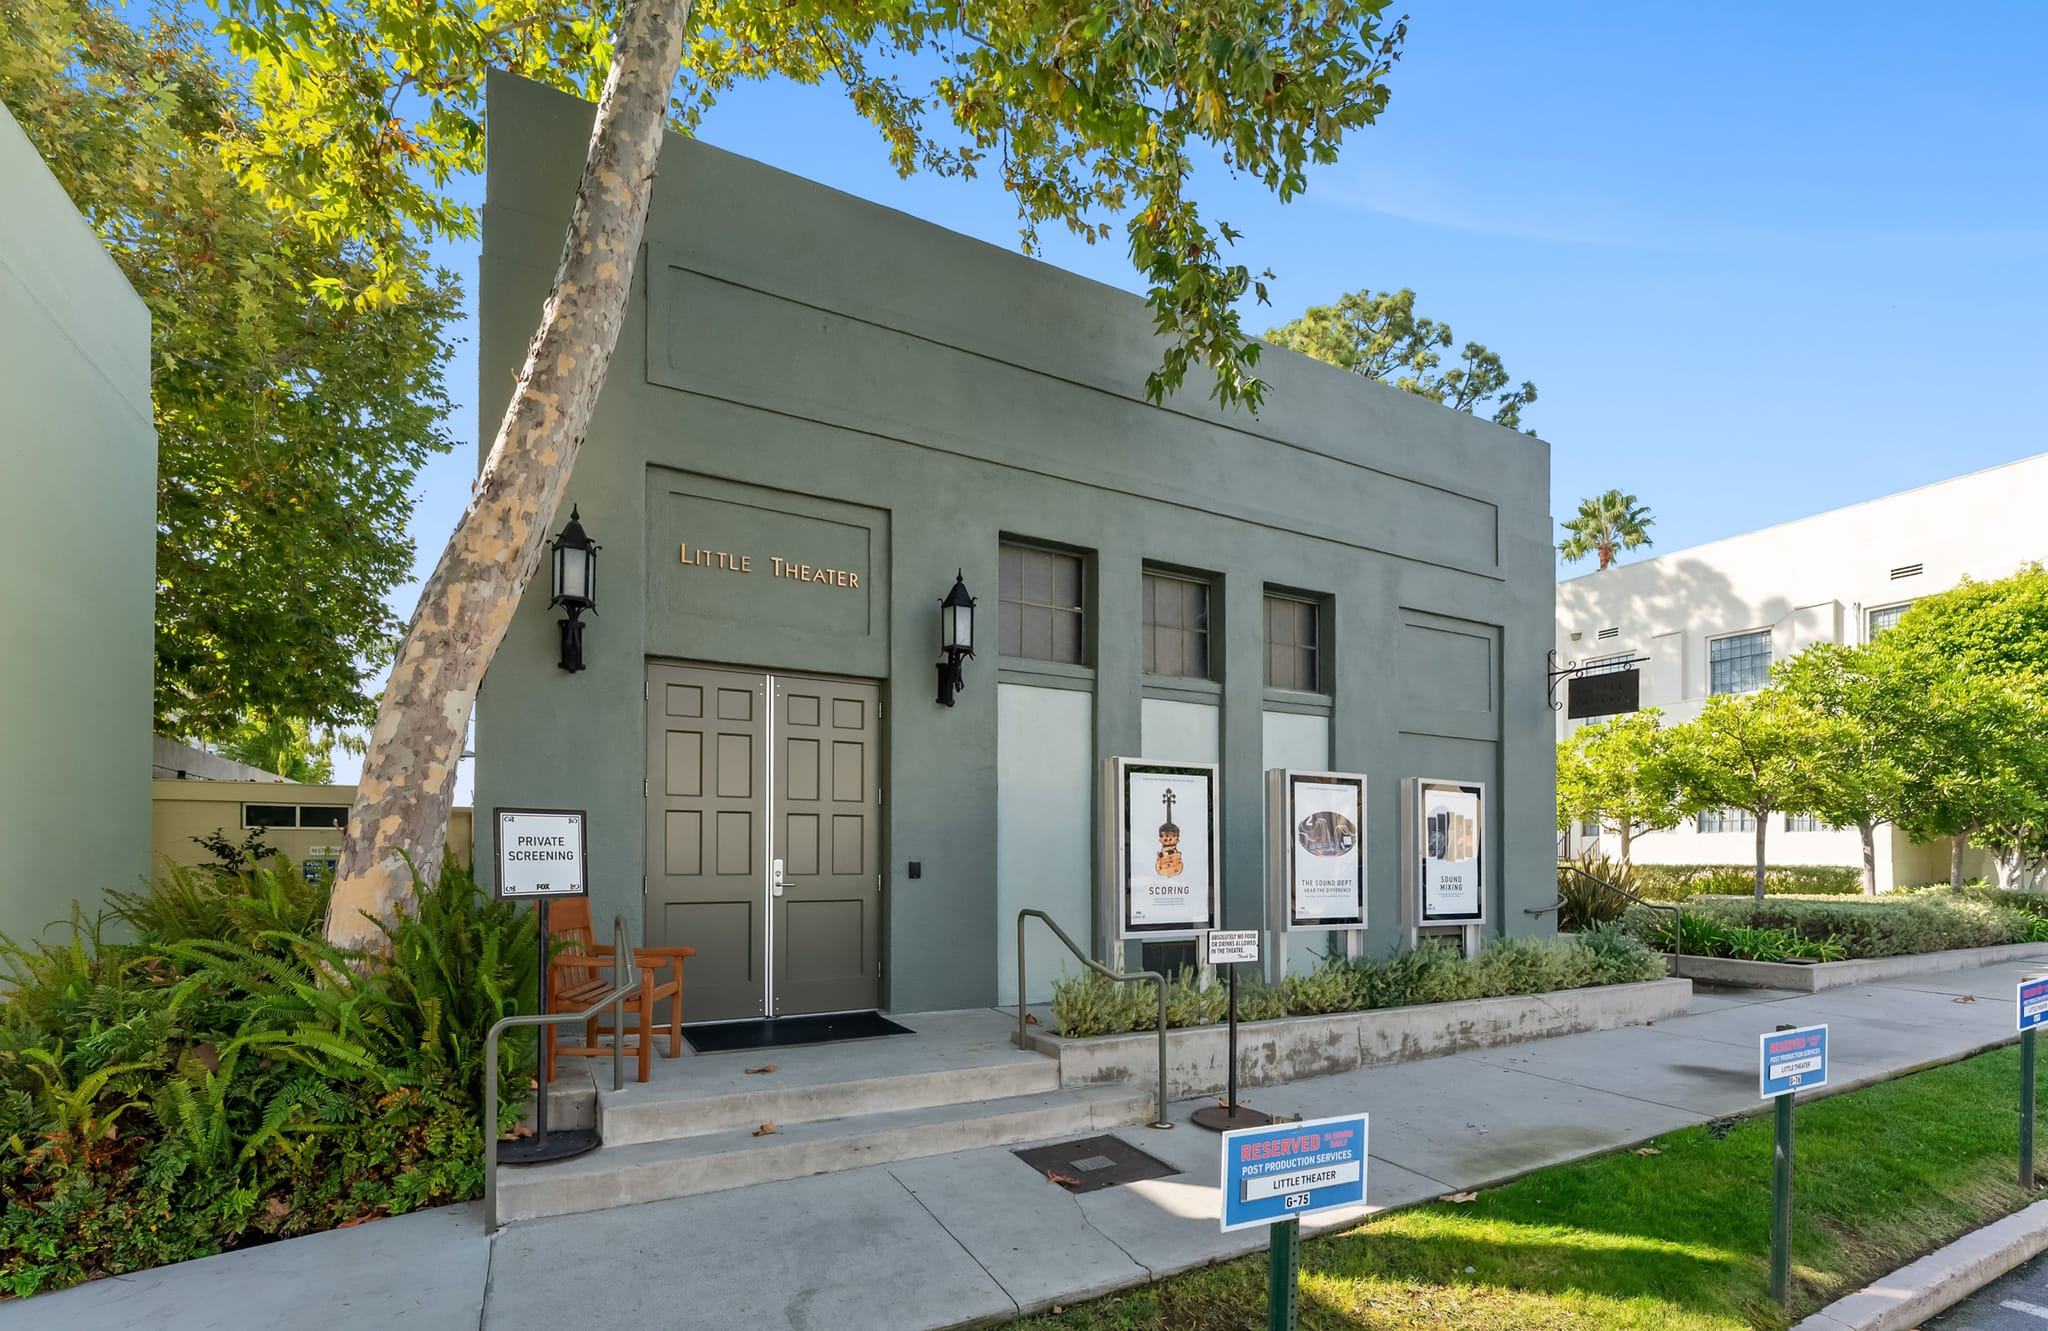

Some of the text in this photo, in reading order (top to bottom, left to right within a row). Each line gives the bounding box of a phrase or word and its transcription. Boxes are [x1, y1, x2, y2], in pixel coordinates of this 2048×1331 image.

[679, 543, 860, 589] LITTLE THEATER
[518, 836, 565, 847] PRIVATE
[508, 850, 574, 861] SCREENING
[1440, 875, 1463, 883] SOUND
[1148, 886, 1190, 895] SCORING
[1440, 883, 1463, 891] MIXING
[1241, 1134, 1320, 1162] RESERVED
[1242, 1149, 1352, 1176] POST PRODUCTION SERVICES
[1273, 1170, 1336, 1190] LITTLE THEATER
[1286, 1193, 1309, 1208] G-75
